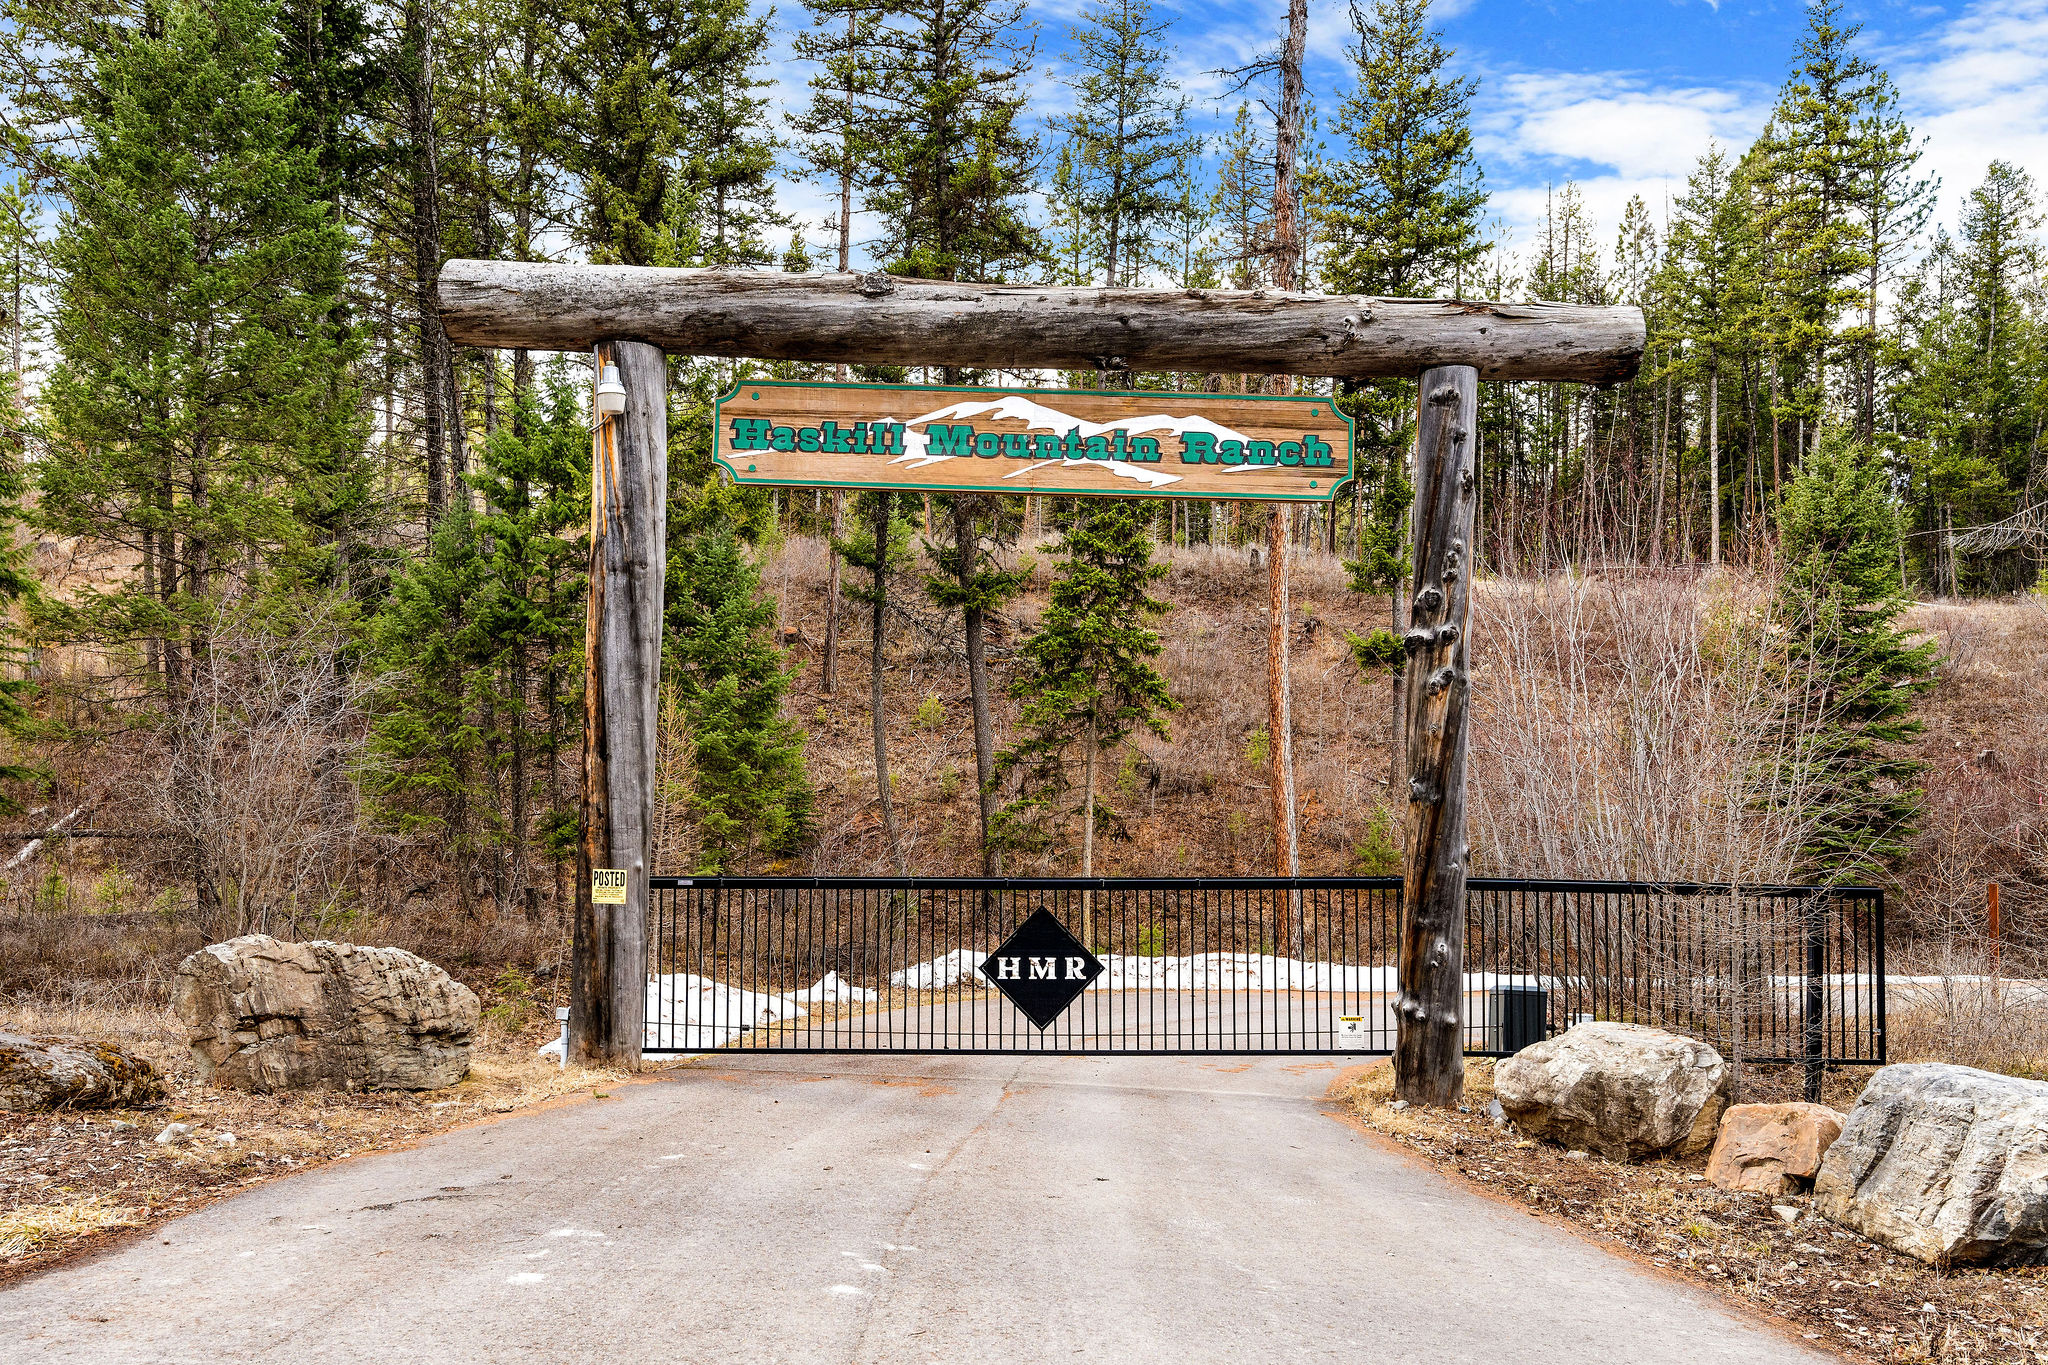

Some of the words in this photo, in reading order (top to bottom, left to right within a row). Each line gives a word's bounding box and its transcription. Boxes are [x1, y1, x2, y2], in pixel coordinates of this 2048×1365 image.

[729, 418, 907, 455] Haskill
[924, 424, 1163, 463] Mountain
[1179, 431, 1335, 468] Ranch
[593, 870, 626, 887] POSTED
[997, 957, 1087, 980] HMR
